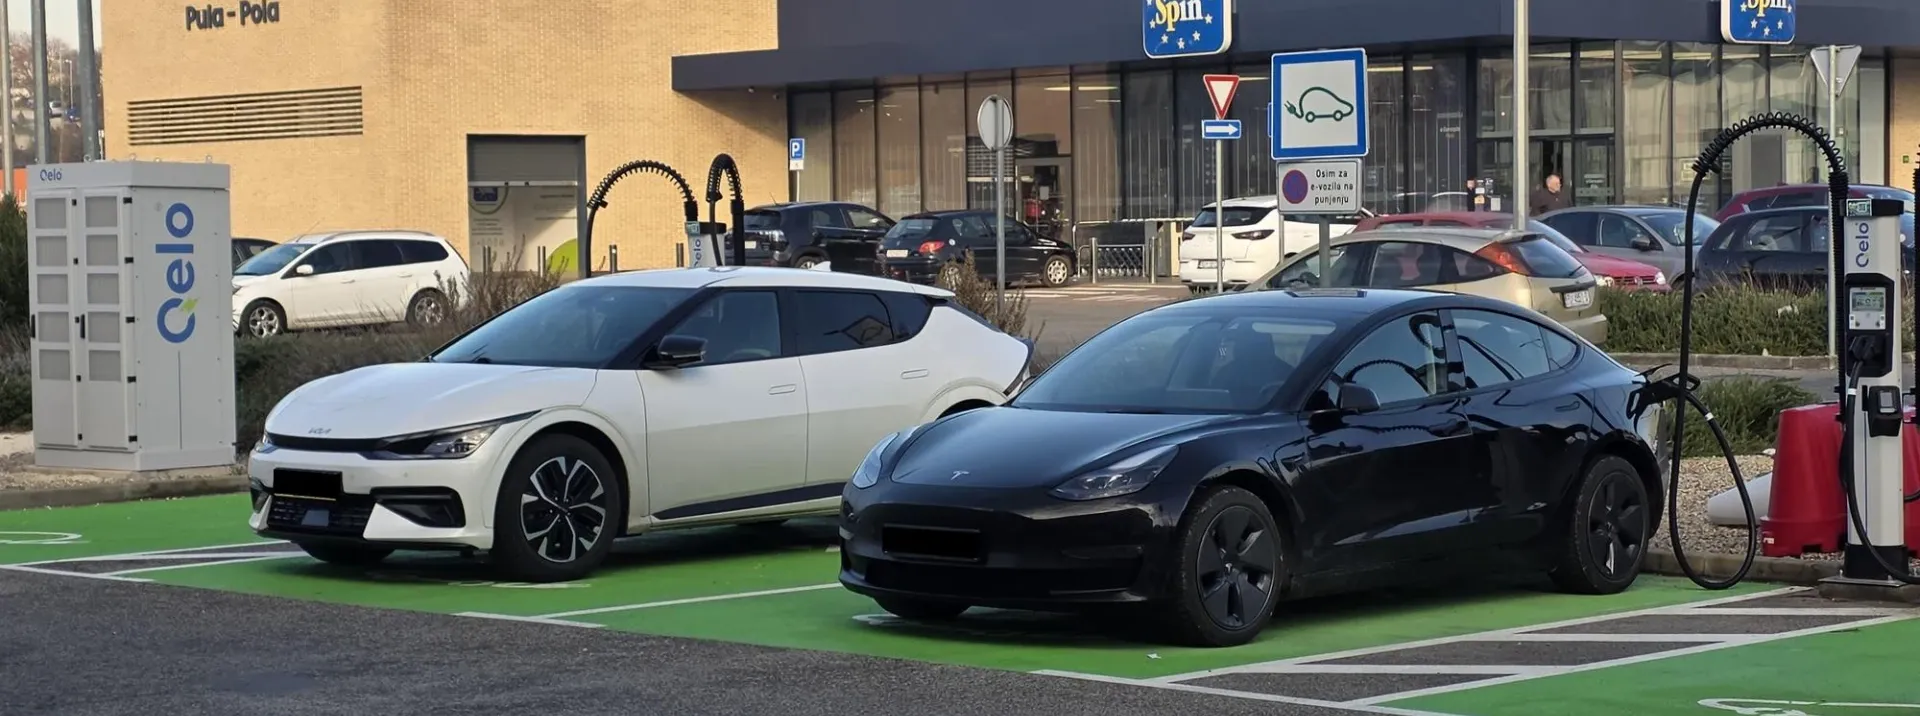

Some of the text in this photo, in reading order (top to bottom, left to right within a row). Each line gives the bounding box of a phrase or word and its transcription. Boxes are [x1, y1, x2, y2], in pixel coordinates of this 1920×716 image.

[185, 4, 224, 31] Pula
[239, 0, 280, 26] Pola
[1155, 0, 1204, 32] Spin
[792, 142, 800, 157] P
[40, 168, 63, 181] Qelo
[1315, 169, 1348, 178] Osim za
[1310, 182, 1354, 191] e-vozila na
[1314, 195, 1349, 206] punjenju
[693, 238, 702, 268] elo
[156, 202, 197, 344] Qelo
